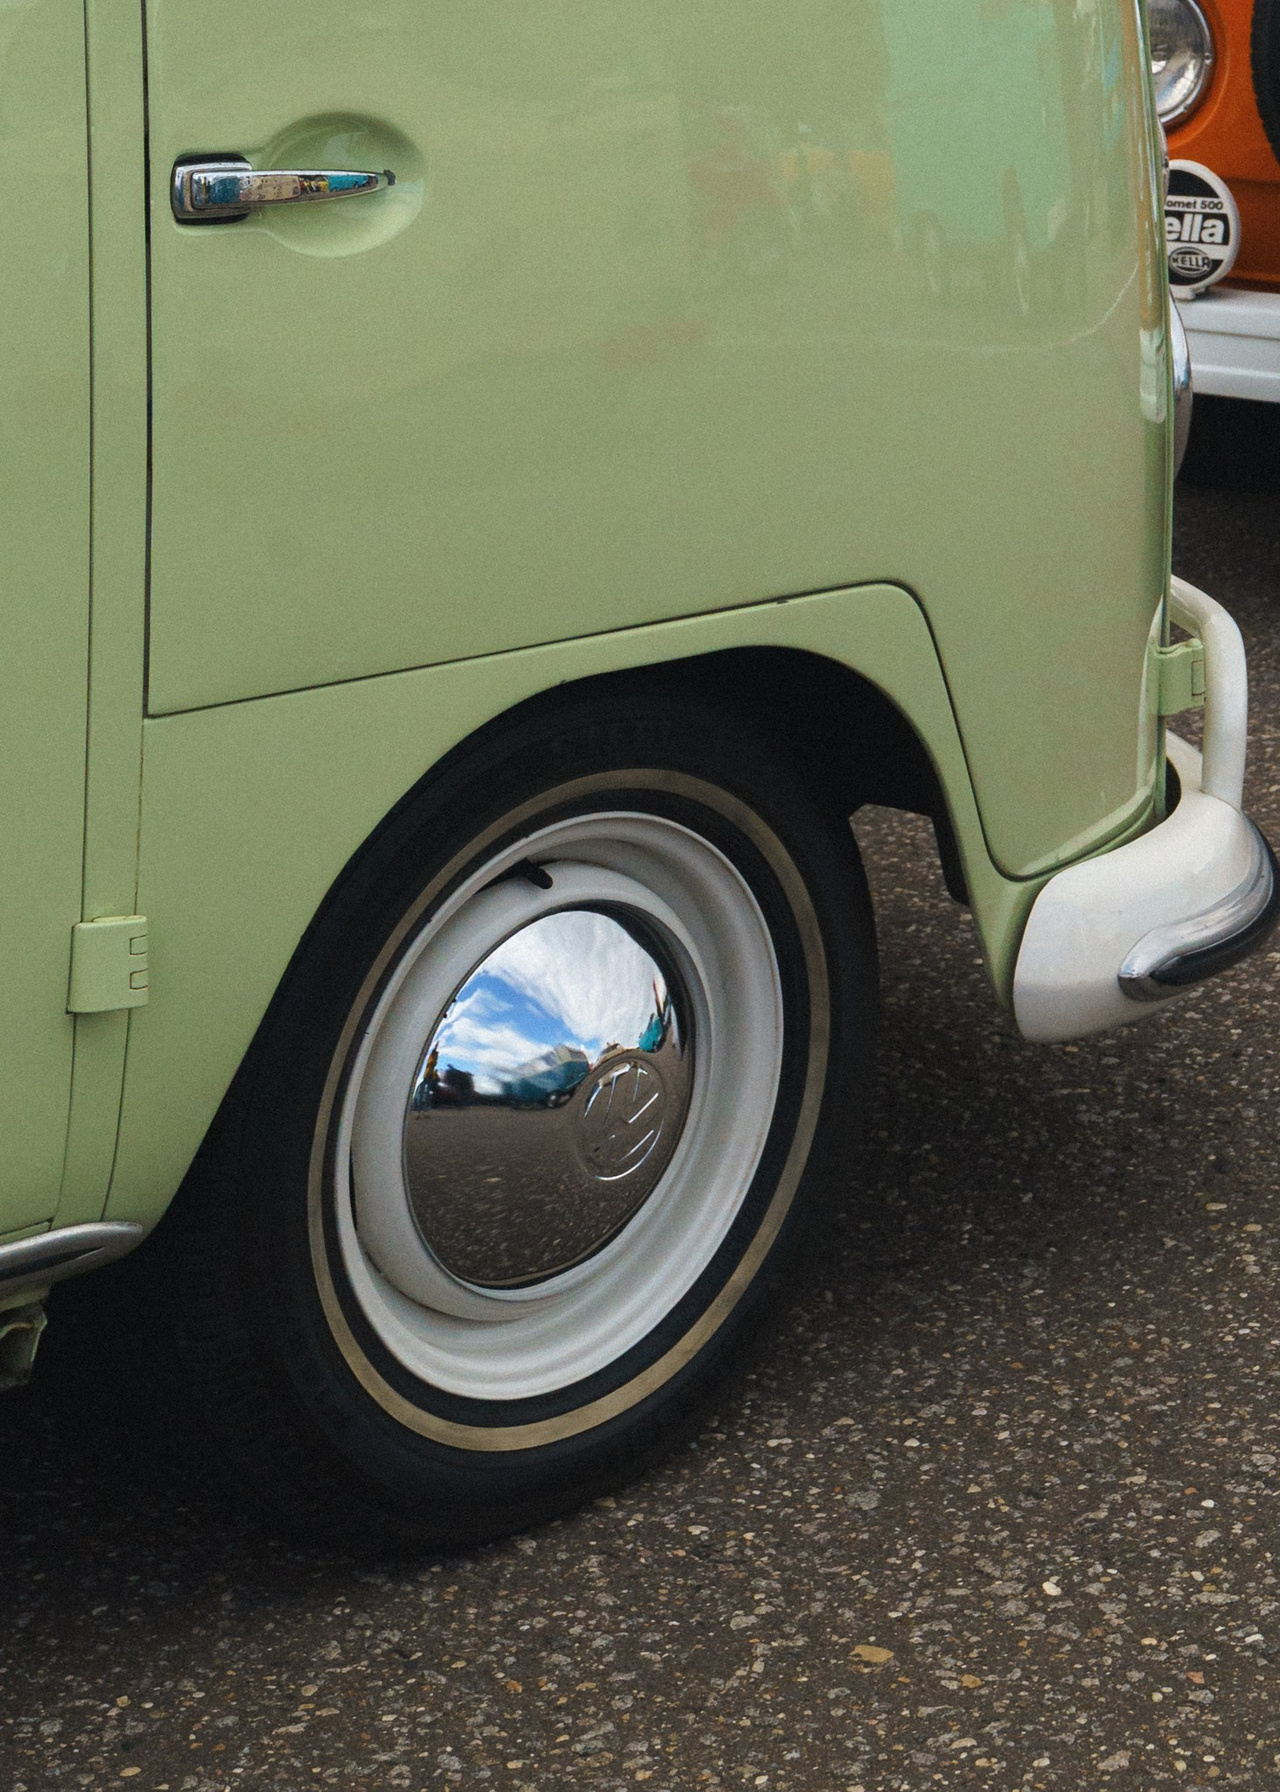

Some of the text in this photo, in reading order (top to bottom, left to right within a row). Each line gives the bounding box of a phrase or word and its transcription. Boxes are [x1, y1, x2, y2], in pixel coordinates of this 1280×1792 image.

[1166, 199, 1224, 211] omet 500
[1165, 212, 1225, 244] ella
[1172, 256, 1211, 269] HELLA
